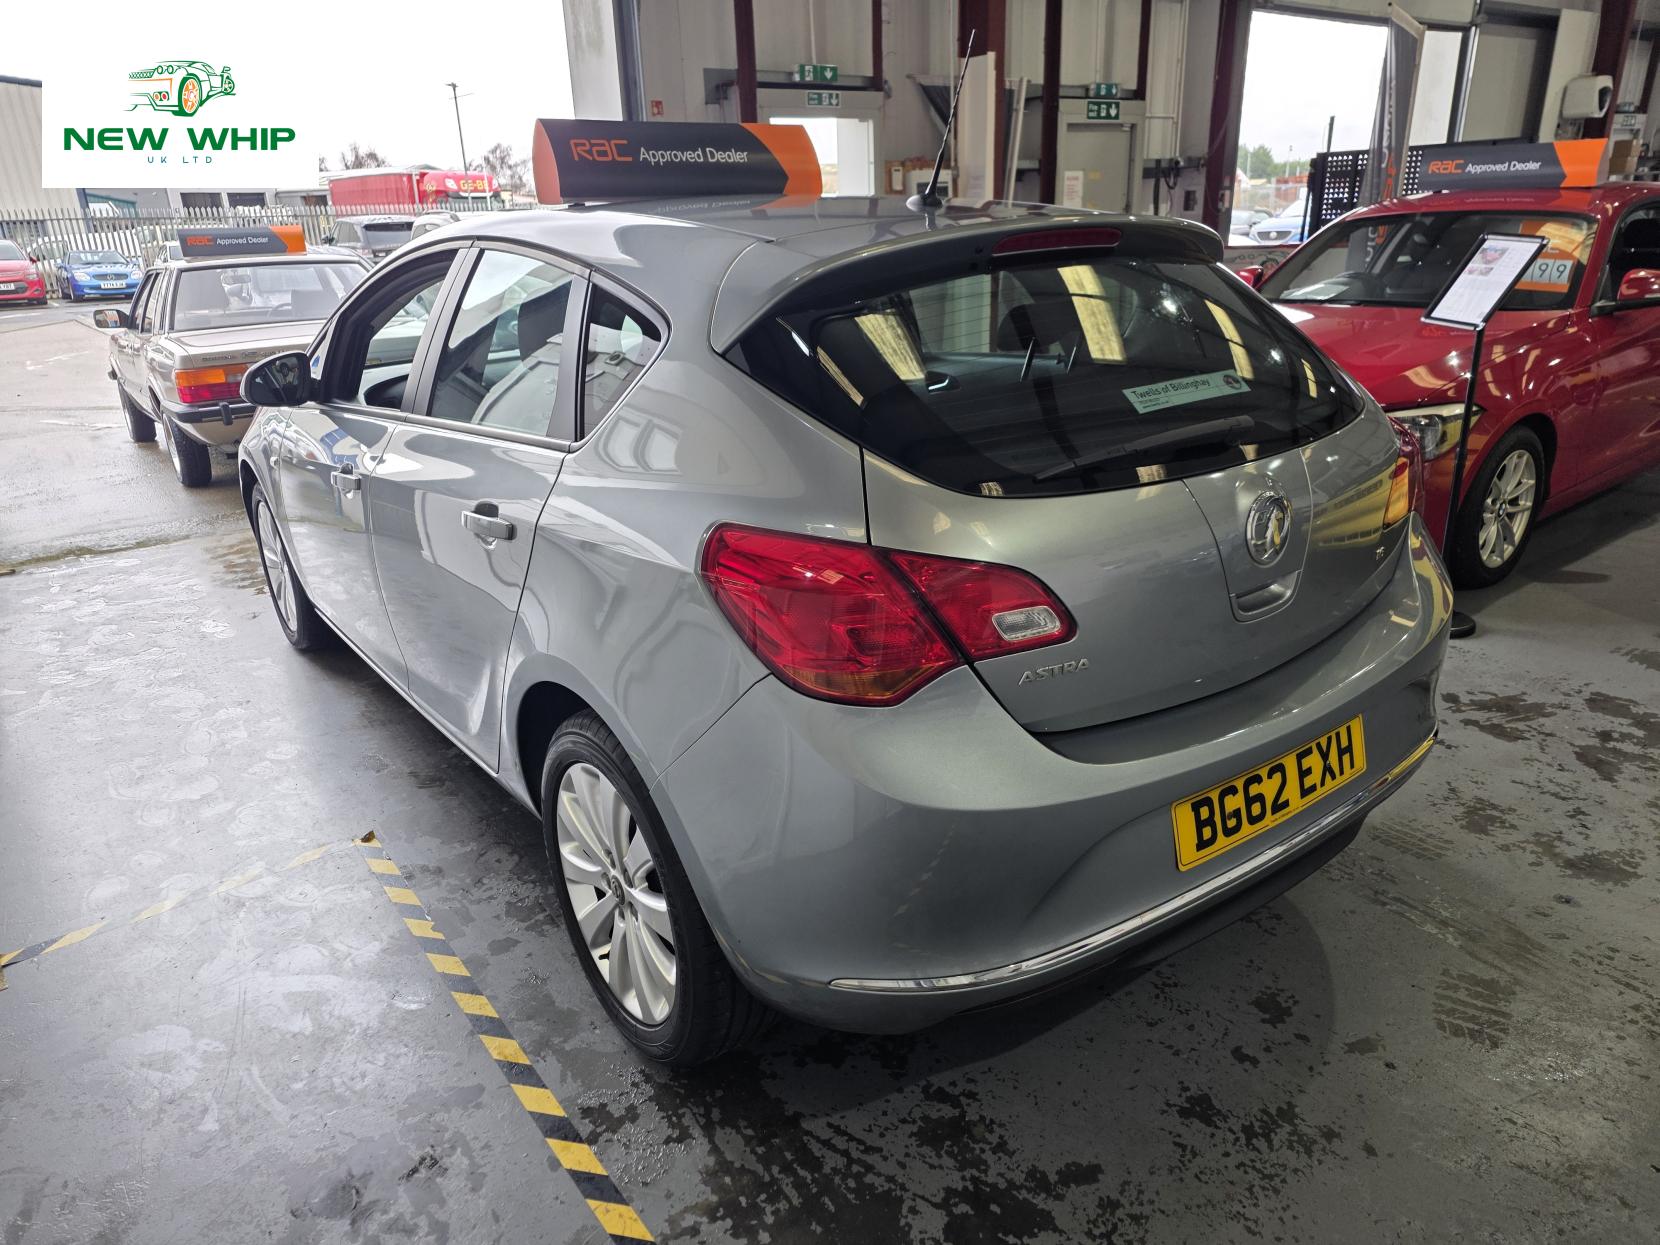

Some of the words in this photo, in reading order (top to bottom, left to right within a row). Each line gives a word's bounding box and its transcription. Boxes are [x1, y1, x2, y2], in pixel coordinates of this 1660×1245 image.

[639, 147, 704, 166] Approved
[706, 147, 748, 163] Dealer
[1465, 161, 1508, 174] Approved
[1510, 160, 1541, 171] Dealer
[216, 236, 247, 246] Approved
[248, 236, 269, 244] Dealer
[1131, 387, 1162, 400] Twells
[1162, 384, 1170, 394] of
[1170, 378, 1211, 391] Billinghay
[1018, 658, 1089, 687] ASTRA
[1191, 762, 1290, 853] BG62
[1296, 725, 1355, 800] EXH
